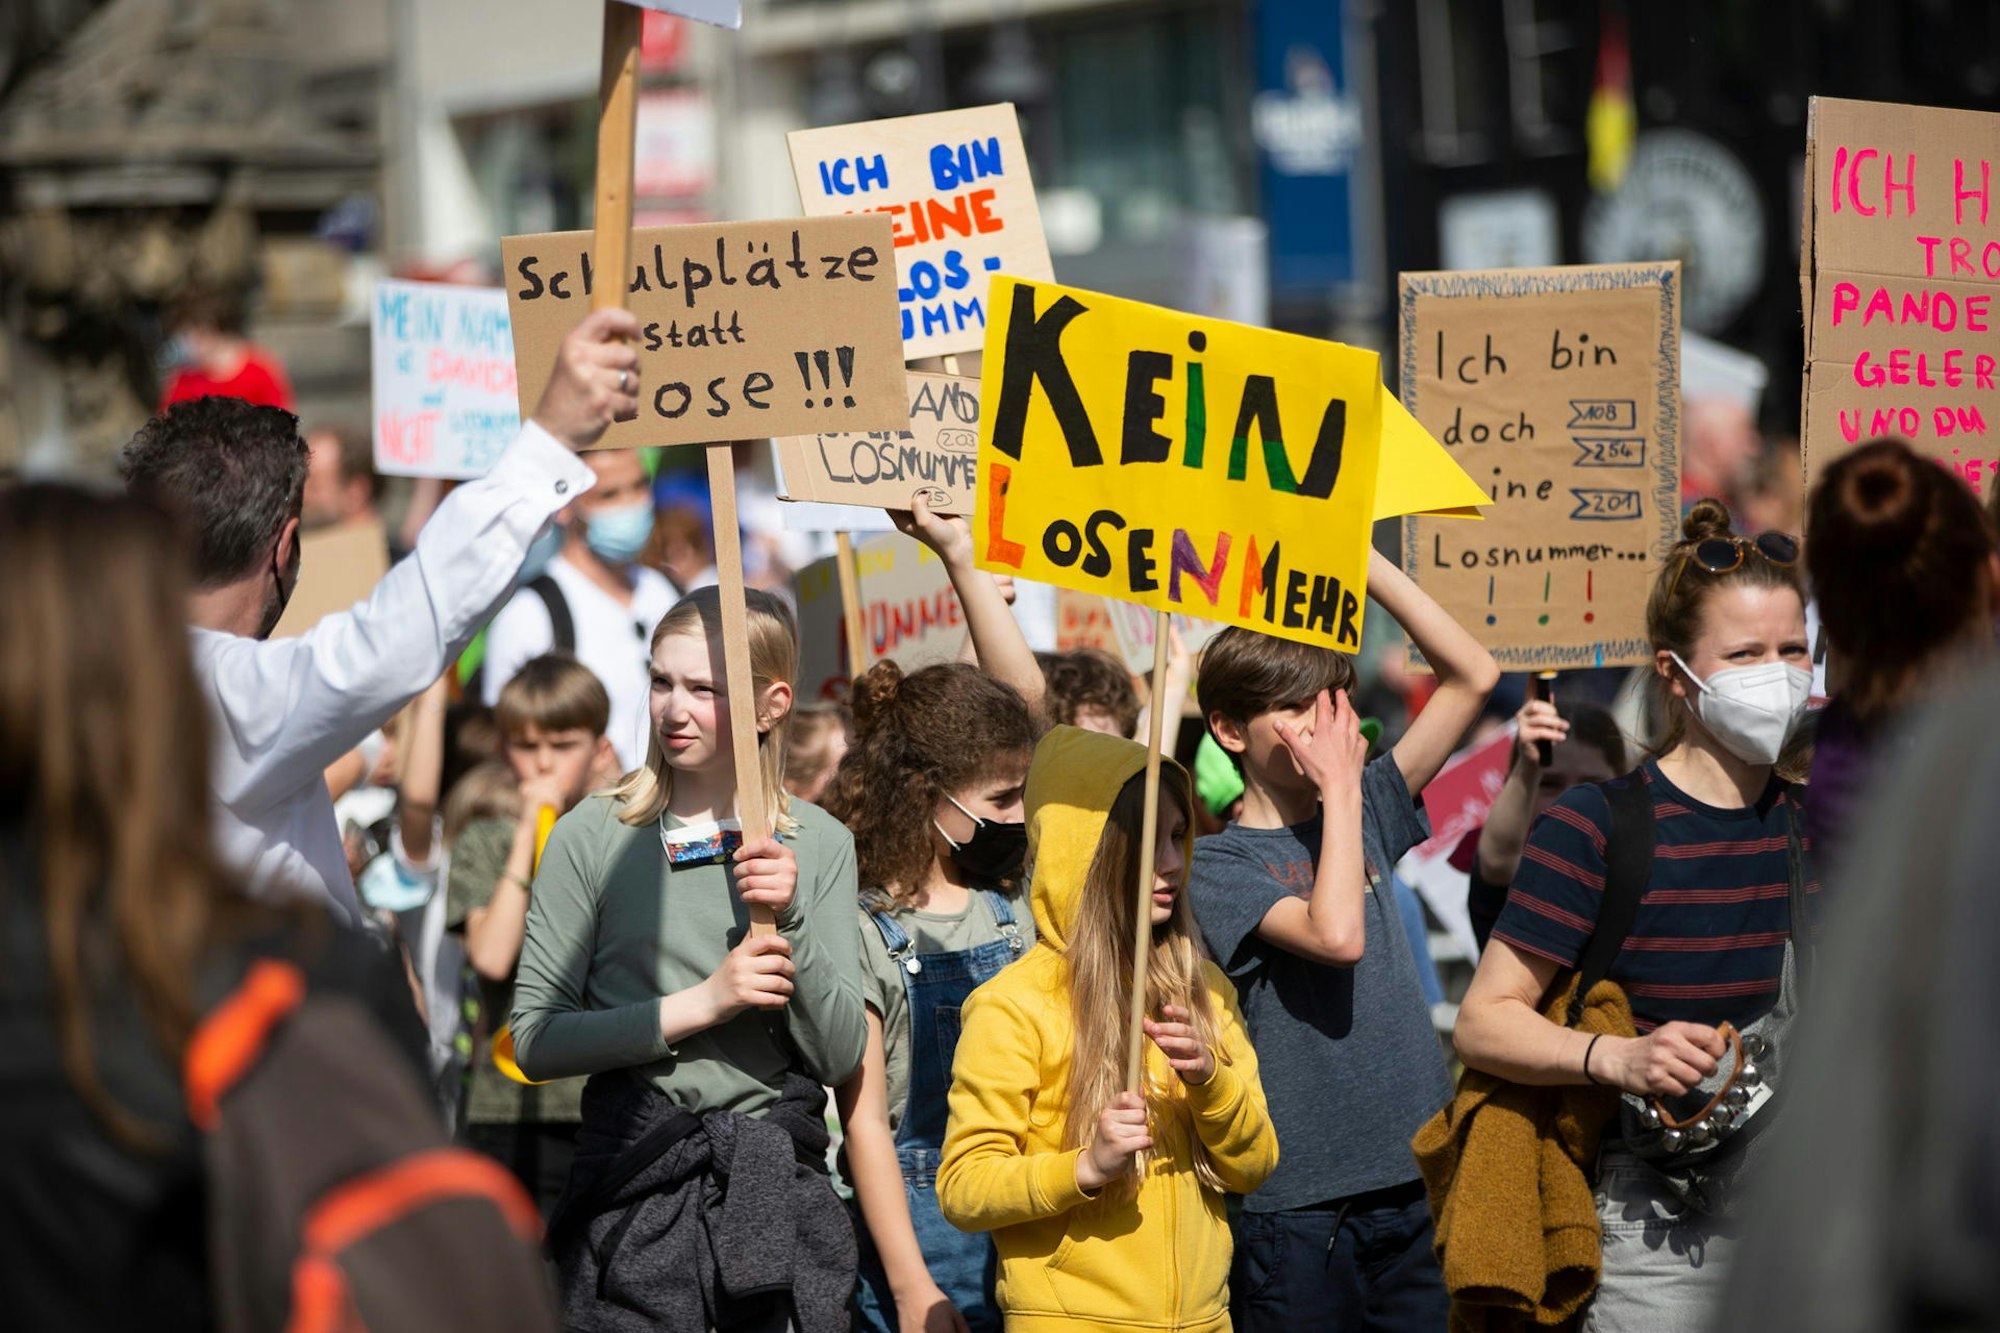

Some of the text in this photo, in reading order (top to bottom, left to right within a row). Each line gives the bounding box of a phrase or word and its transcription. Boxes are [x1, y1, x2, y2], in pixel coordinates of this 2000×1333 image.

[819, 136, 1004, 196] ICH BIN
[1831, 145, 1917, 218] ICH
[1953, 158, 1991, 226] H
[845, 188, 1004, 248] EINE
[643, 310, 746, 351] statt
[1832, 282, 1992, 333] PANDE
[1437, 329, 1618, 384] Ich bin
[1853, 348, 1997, 390] GELER
[614, 345, 857, 423] ose !!!
[1444, 406, 1535, 446] doch
[1839, 407, 1921, 444] UND
[1594, 443, 1633, 462] 254
